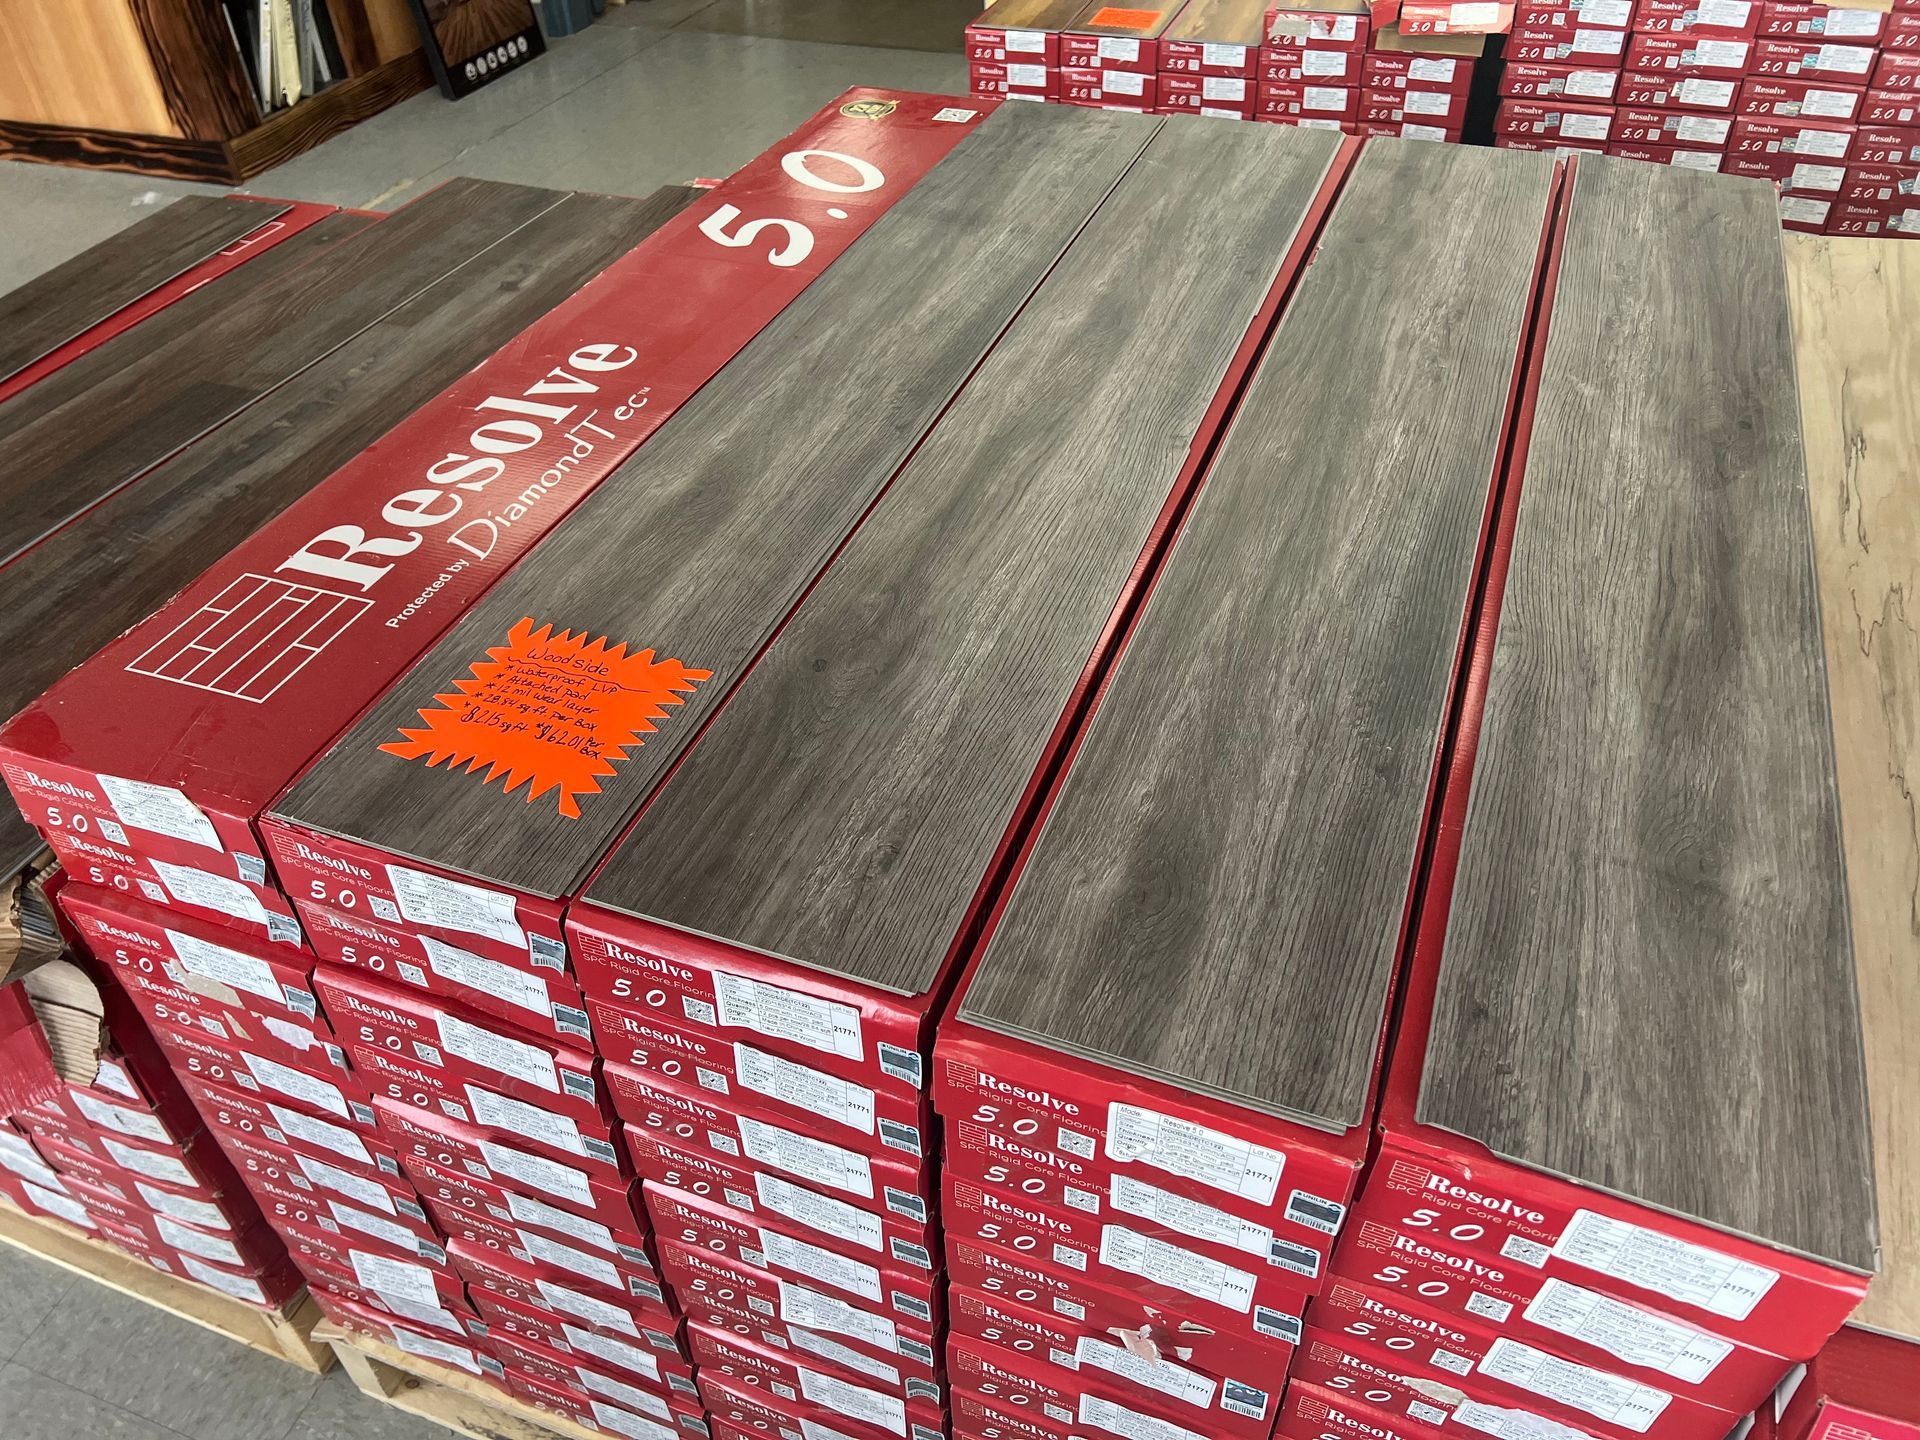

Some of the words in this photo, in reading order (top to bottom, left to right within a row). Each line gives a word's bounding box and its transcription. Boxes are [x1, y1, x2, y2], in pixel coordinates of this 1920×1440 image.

[1651, 1, 1683, 11] Resolve
[1776, 3, 1809, 13] Resolve
[1409, 22, 1430, 32] 5.0
[1526, 14, 1548, 24] 5.0
[1644, 19, 1667, 30] 5.0
[1768, 21, 1792, 32] 5.0
[1524, 31, 1554, 40] Resolve
[1646, 39, 1677, 49] Resolve
[1892, 35, 1918, 46] 5.0
[1518, 48, 1540, 58] 5.0
[1767, 44, 1799, 54] Resolve
[1759, 62, 1783, 72] 5.0
[1371, 76, 1391, 86] 5.0
[1754, 85, 1786, 95] Resolve
[1266, 103, 1286, 112] 5.0
[1368, 109, 1388, 119] 5.0
[1628, 112, 1659, 122] Resolve
[1747, 102, 1770, 113] 5.0
[1869, 134, 1901, 144] Resolve
[1859, 171, 1891, 181] Resolve
[1851, 188, 1875, 198] 5.0
[698, 150, 886, 267] 5.0
[273, 343, 638, 592] Resolve
[385, 572, 452, 628] Protected
[449, 558, 469, 576] by
[497, 685, 509, 694] 12
[514, 688, 531, 696] mil
[534, 692, 562, 704] wear
[563, 700, 599, 715] layer
[507, 676, 560, 694] Attached
[565, 689, 591, 700] pad
[592, 683, 618, 694] LVP
[574, 718, 597, 731] Box
[25, 771, 96, 802] Resolve
[47, 807, 88, 833] 5.0
[67, 835, 136, 865] Resolve
[295, 843, 372, 880] Resolve
[89, 867, 129, 890] 5.0
[280, 855, 301, 867] SPC
[304, 863, 330, 876] Rigid
[331, 872, 355, 885] Core
[357, 881, 395, 897] Floorin
[310, 880, 356, 908] 5.0
[495, 916, 517, 927] 21771
[95, 920, 162, 950] Resolve
[115, 950, 154, 973] 5.0
[340, 947, 385, 972] 5.0
[604, 942, 694, 982] Resolve
[583, 953, 607, 966] SPC
[610, 961, 640, 976] Rigid
[643, 972, 670, 985] Core
[674, 981, 716, 999] Floorin
[138, 976, 201, 1004] Resolve
[523, 984, 545, 996] 21771
[611, 978, 666, 1007] 5.0
[155, 1004, 192, 1026] 5.0
[348, 996, 418, 1030] Resolve
[359, 1026, 402, 1050] 5.0
[621, 1015, 707, 1055] Resolve
[834, 1025, 857, 1037] 21771
[172, 1032, 233, 1062] Resolve
[188, 1058, 225, 1079] 5.0
[375, 1055, 443, 1088] Resolve
[532, 1062, 552, 1074] 21771
[629, 1049, 682, 1077] 5.0
[203, 1088, 262, 1116] Resolve
[388, 1084, 429, 1106] 5.0
[637, 1081, 717, 1121] Resolve
[947, 1079, 975, 1092] SPC
[978, 1088, 1013, 1105] Rigid
[1017, 1102, 1049, 1117] Core
[978, 1071, 1080, 1116] Resolve
[847, 1101, 871, 1114] 21771
[972, 1104, 1039, 1135] 5.0
[218, 1111, 253, 1132] 5.0
[645, 1112, 695, 1138] 5.0
[400, 1118, 466, 1151] Resolve
[414, 1144, 453, 1166] 5.0
[657, 1143, 733, 1179] Resolve
[988, 1132, 1083, 1175] Resolve
[960, 1141, 986, 1153] SPC
[989, 1151, 1021, 1166] Rigid
[1025, 1162, 1054, 1177] Core
[1059, 1173, 1111, 1195] Flooring
[983, 1166, 1045, 1193] 5.0
[1245, 1168, 1273, 1183] 21771
[663, 1171, 711, 1195] 5.0
[1302, 1193, 1327, 1205] UNILIN
[1425, 1173, 1545, 1224] Resolve
[674, 1204, 748, 1238] Resolve
[982, 1194, 1073, 1233] Resolve
[1386, 1181, 1418, 1196] SPC
[1422, 1193, 1462, 1210] Rigid
[1465, 1207, 1502, 1224] Core
[1506, 1220, 1559, 1242] Floorin
[977, 1223, 1038, 1250] 5.0
[1240, 1224, 1269, 1238] 21771
[1402, 1208, 1485, 1241] 5.0
[681, 1228, 727, 1252] 5.0
[1394, 1234, 1505, 1282] Resolve
[687, 1254, 757, 1289] Resolve
[983, 1253, 1070, 1292] Resolve
[1356, 1240, 1386, 1254] SPC
[1390, 1251, 1427, 1268] Rigid
[1432, 1265, 1466, 1281] Core
[1469, 1278, 1531, 1304] Flooring
[1372, 1266, 1450, 1296] 5.0
[690, 1279, 735, 1301] 5.0
[981, 1278, 1038, 1301] 5.0
[1222, 1280, 1248, 1295] 21771
[1722, 1282, 1756, 1298] 21771
[983, 1305, 1067, 1342] Resolve
[1363, 1299, 1466, 1342] Resolve
[980, 1328, 1035, 1352] 5.0
[1344, 1322, 1415, 1350] 5.0
[716, 1343, 780, 1375] Resolve
[1681, 1350, 1712, 1365] 21771
[720, 1365, 760, 1385] 5.0
[980, 1360, 1059, 1398] Resolve
[1340, 1354, 1410, 1386] Reso
[978, 1383, 1030, 1405] 5.0
[1325, 1376, 1392, 1402] 5.0
[1625, 1401, 1654, 1415] 21771
